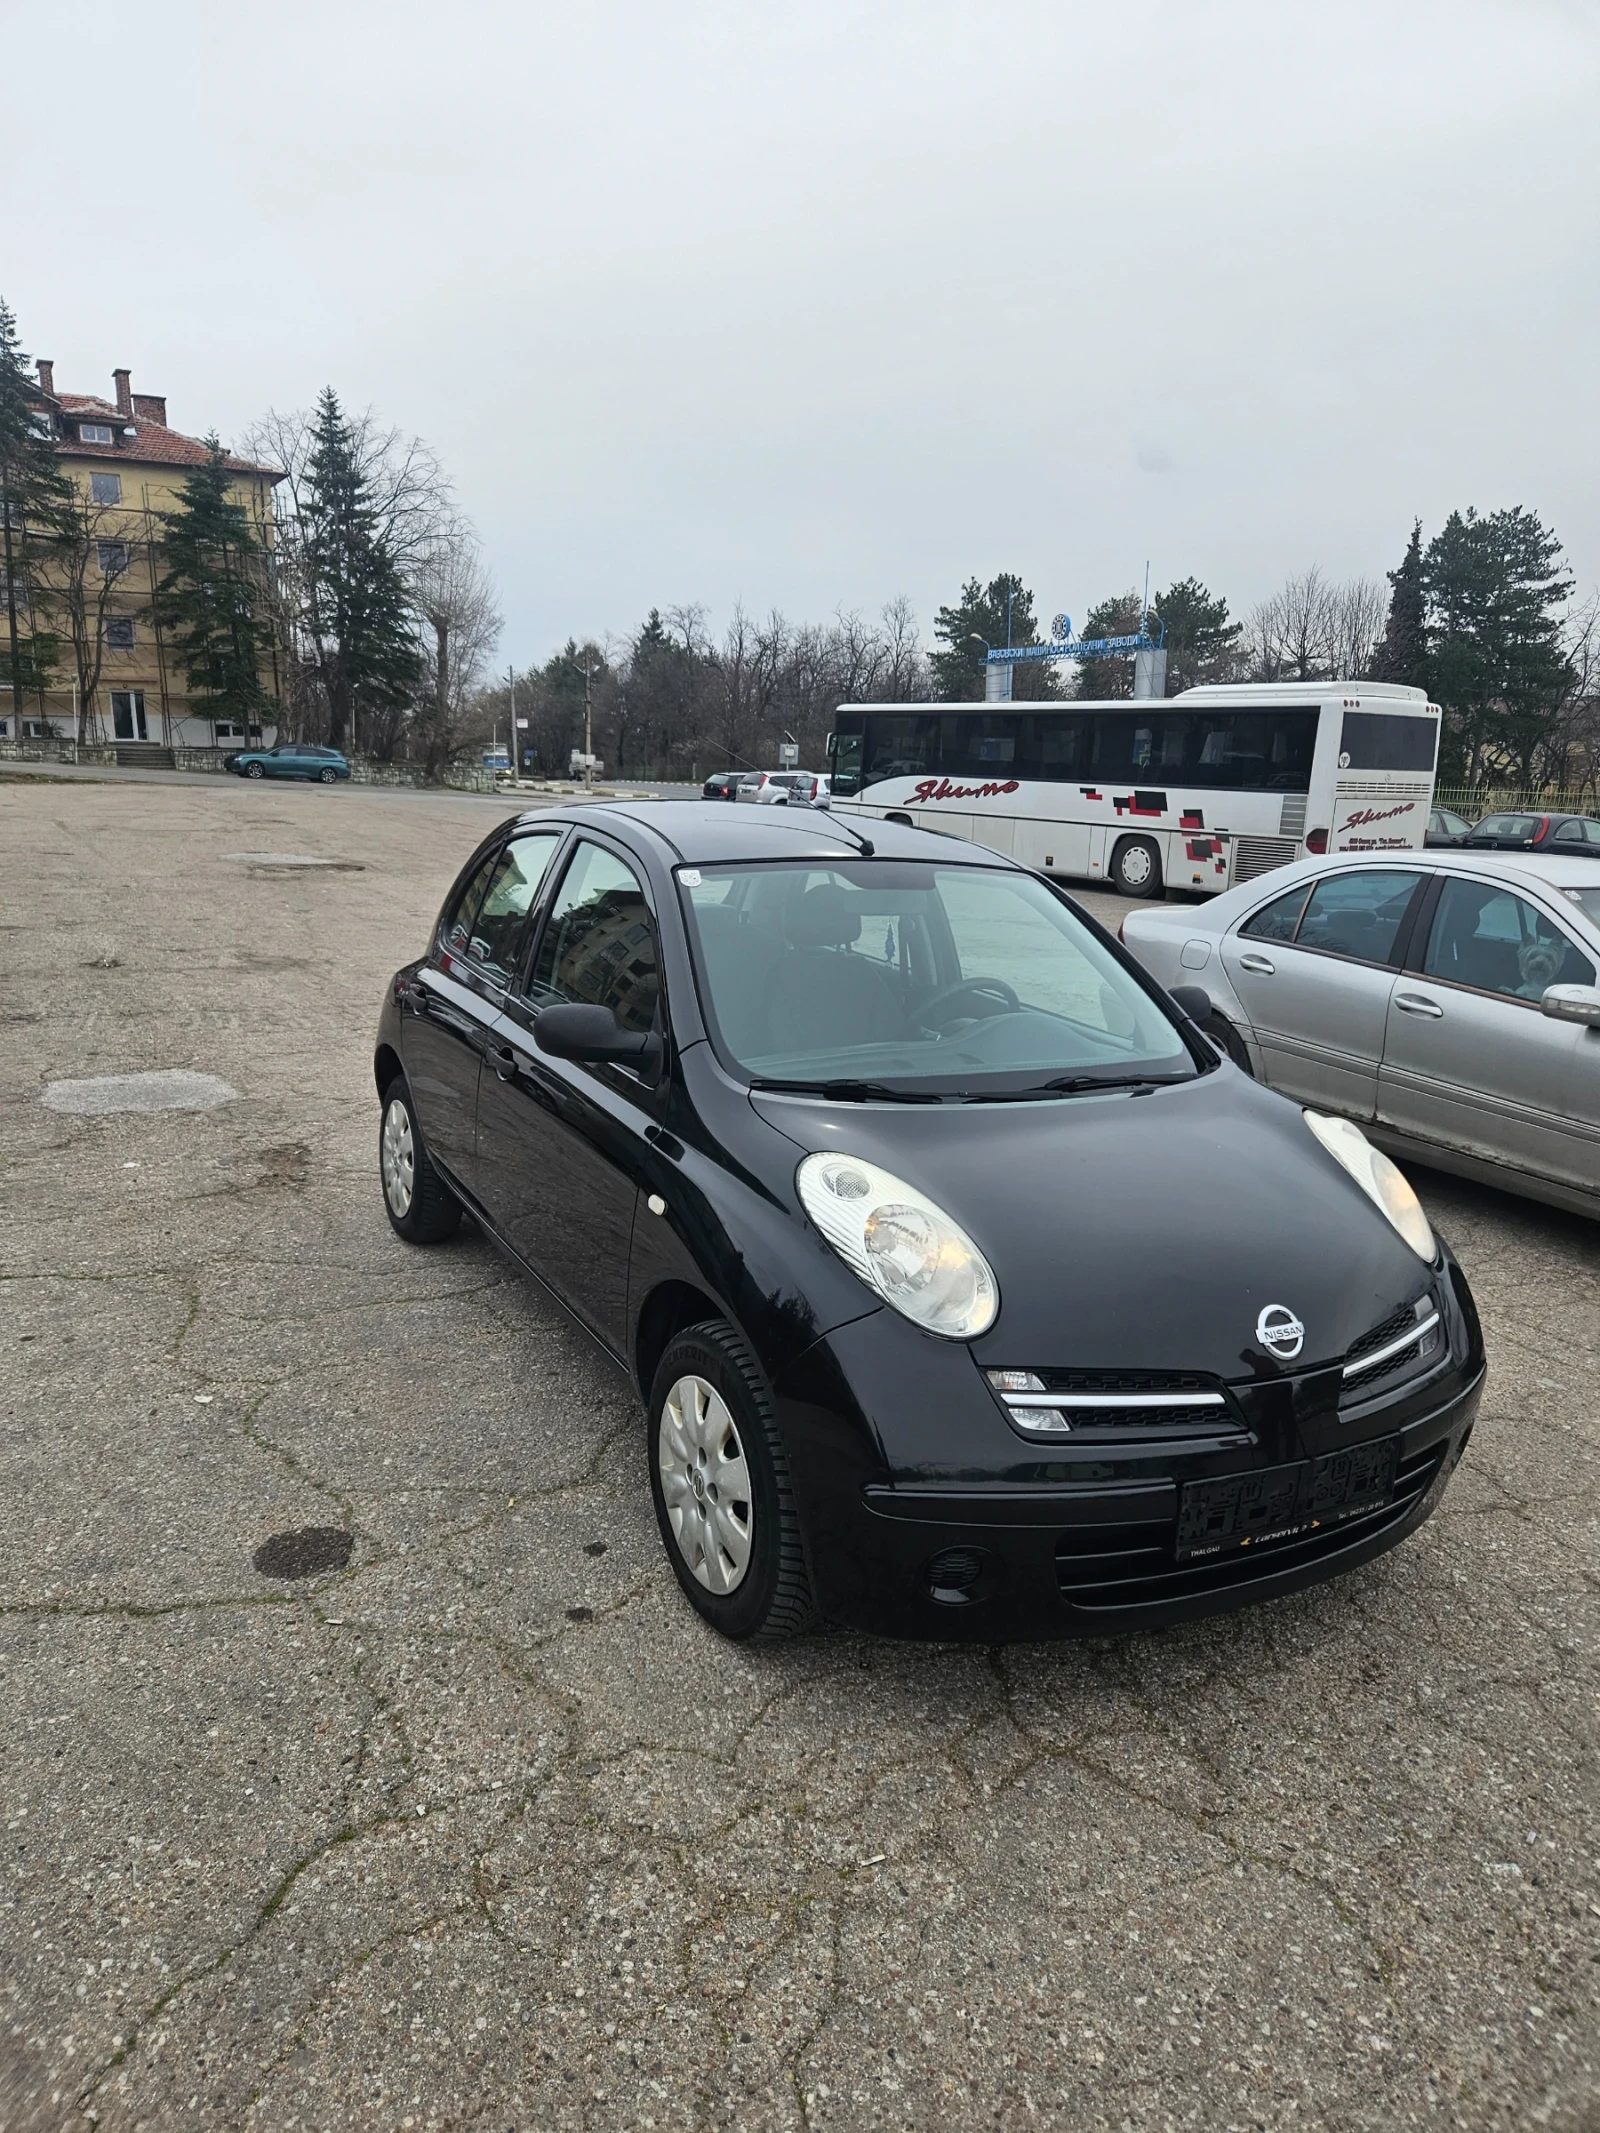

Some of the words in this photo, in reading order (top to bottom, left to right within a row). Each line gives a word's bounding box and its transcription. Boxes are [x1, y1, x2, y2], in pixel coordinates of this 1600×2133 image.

[987, 648, 1024, 659] ВАЗОВСКИ
[1106, 634, 1139, 648] ЗАВОДИ
[1264, 1326, 1303, 1341] NISSAN
[1190, 1545, 1221, 1557] THALGAU
